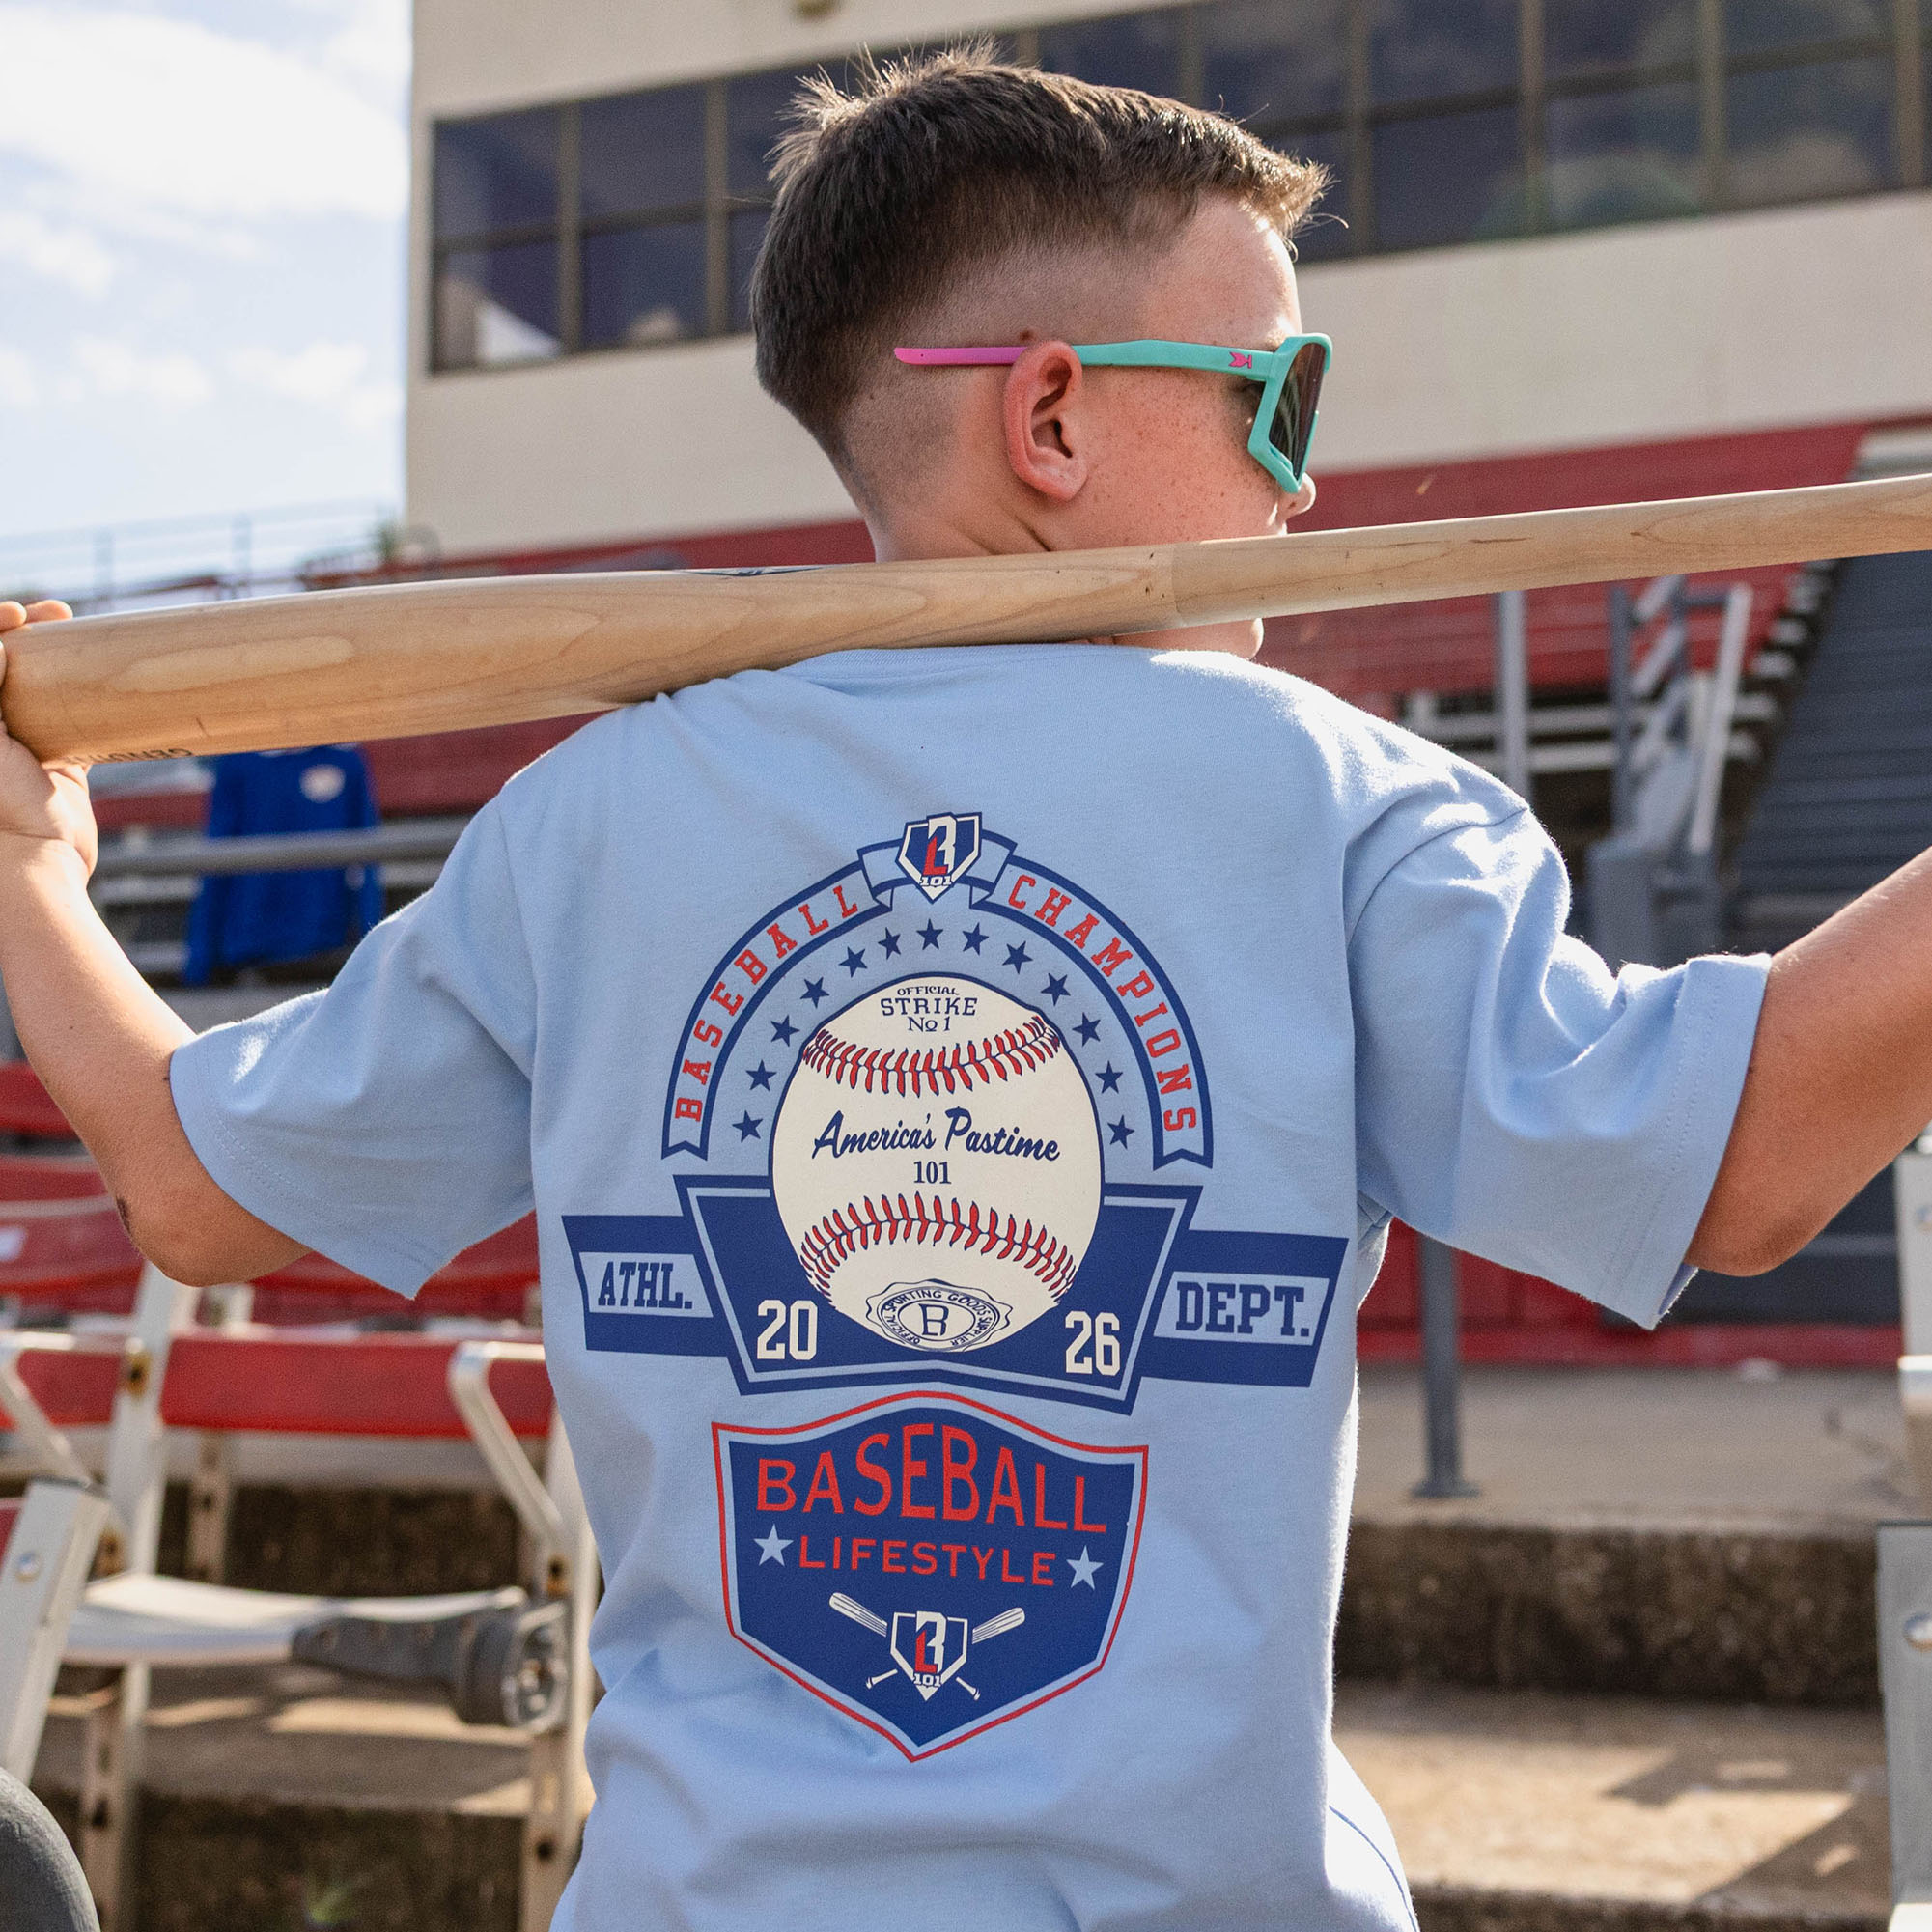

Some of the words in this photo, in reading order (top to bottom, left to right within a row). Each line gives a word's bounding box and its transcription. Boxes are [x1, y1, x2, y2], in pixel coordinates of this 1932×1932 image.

[920, 876, 951, 887] 101
[675, 885, 858, 1122] BASEBALL
[1007, 875, 1196, 1132] CHAMPIONS
[897, 985, 960, 996] OFFICIAL
[880, 997, 978, 1017] STRIKE
[942, 1016, 951, 1032] 1
[812, 1109, 937, 1159] America's
[944, 1106, 1060, 1162] Pastime
[913, 1161, 952, 1185] 101
[598, 1261, 693, 1309] ATHL.
[1175, 1280, 1310, 1338] DEPT.
[884, 1289, 942, 1313] SPORTING
[947, 1293, 991, 1317] GOODS
[884, 1313, 921, 1345] OFFICIAL
[918, 1303, 949, 1336] B
[950, 1316, 993, 1346] SUPPLIER
[757, 1300, 818, 1360] 20
[1065, 1310, 1121, 1376] 26
[756, 1422, 1106, 1533] BASEBALL
[799, 1535, 1056, 1586] LIFESTYLE
[913, 1673, 941, 1687] 101
